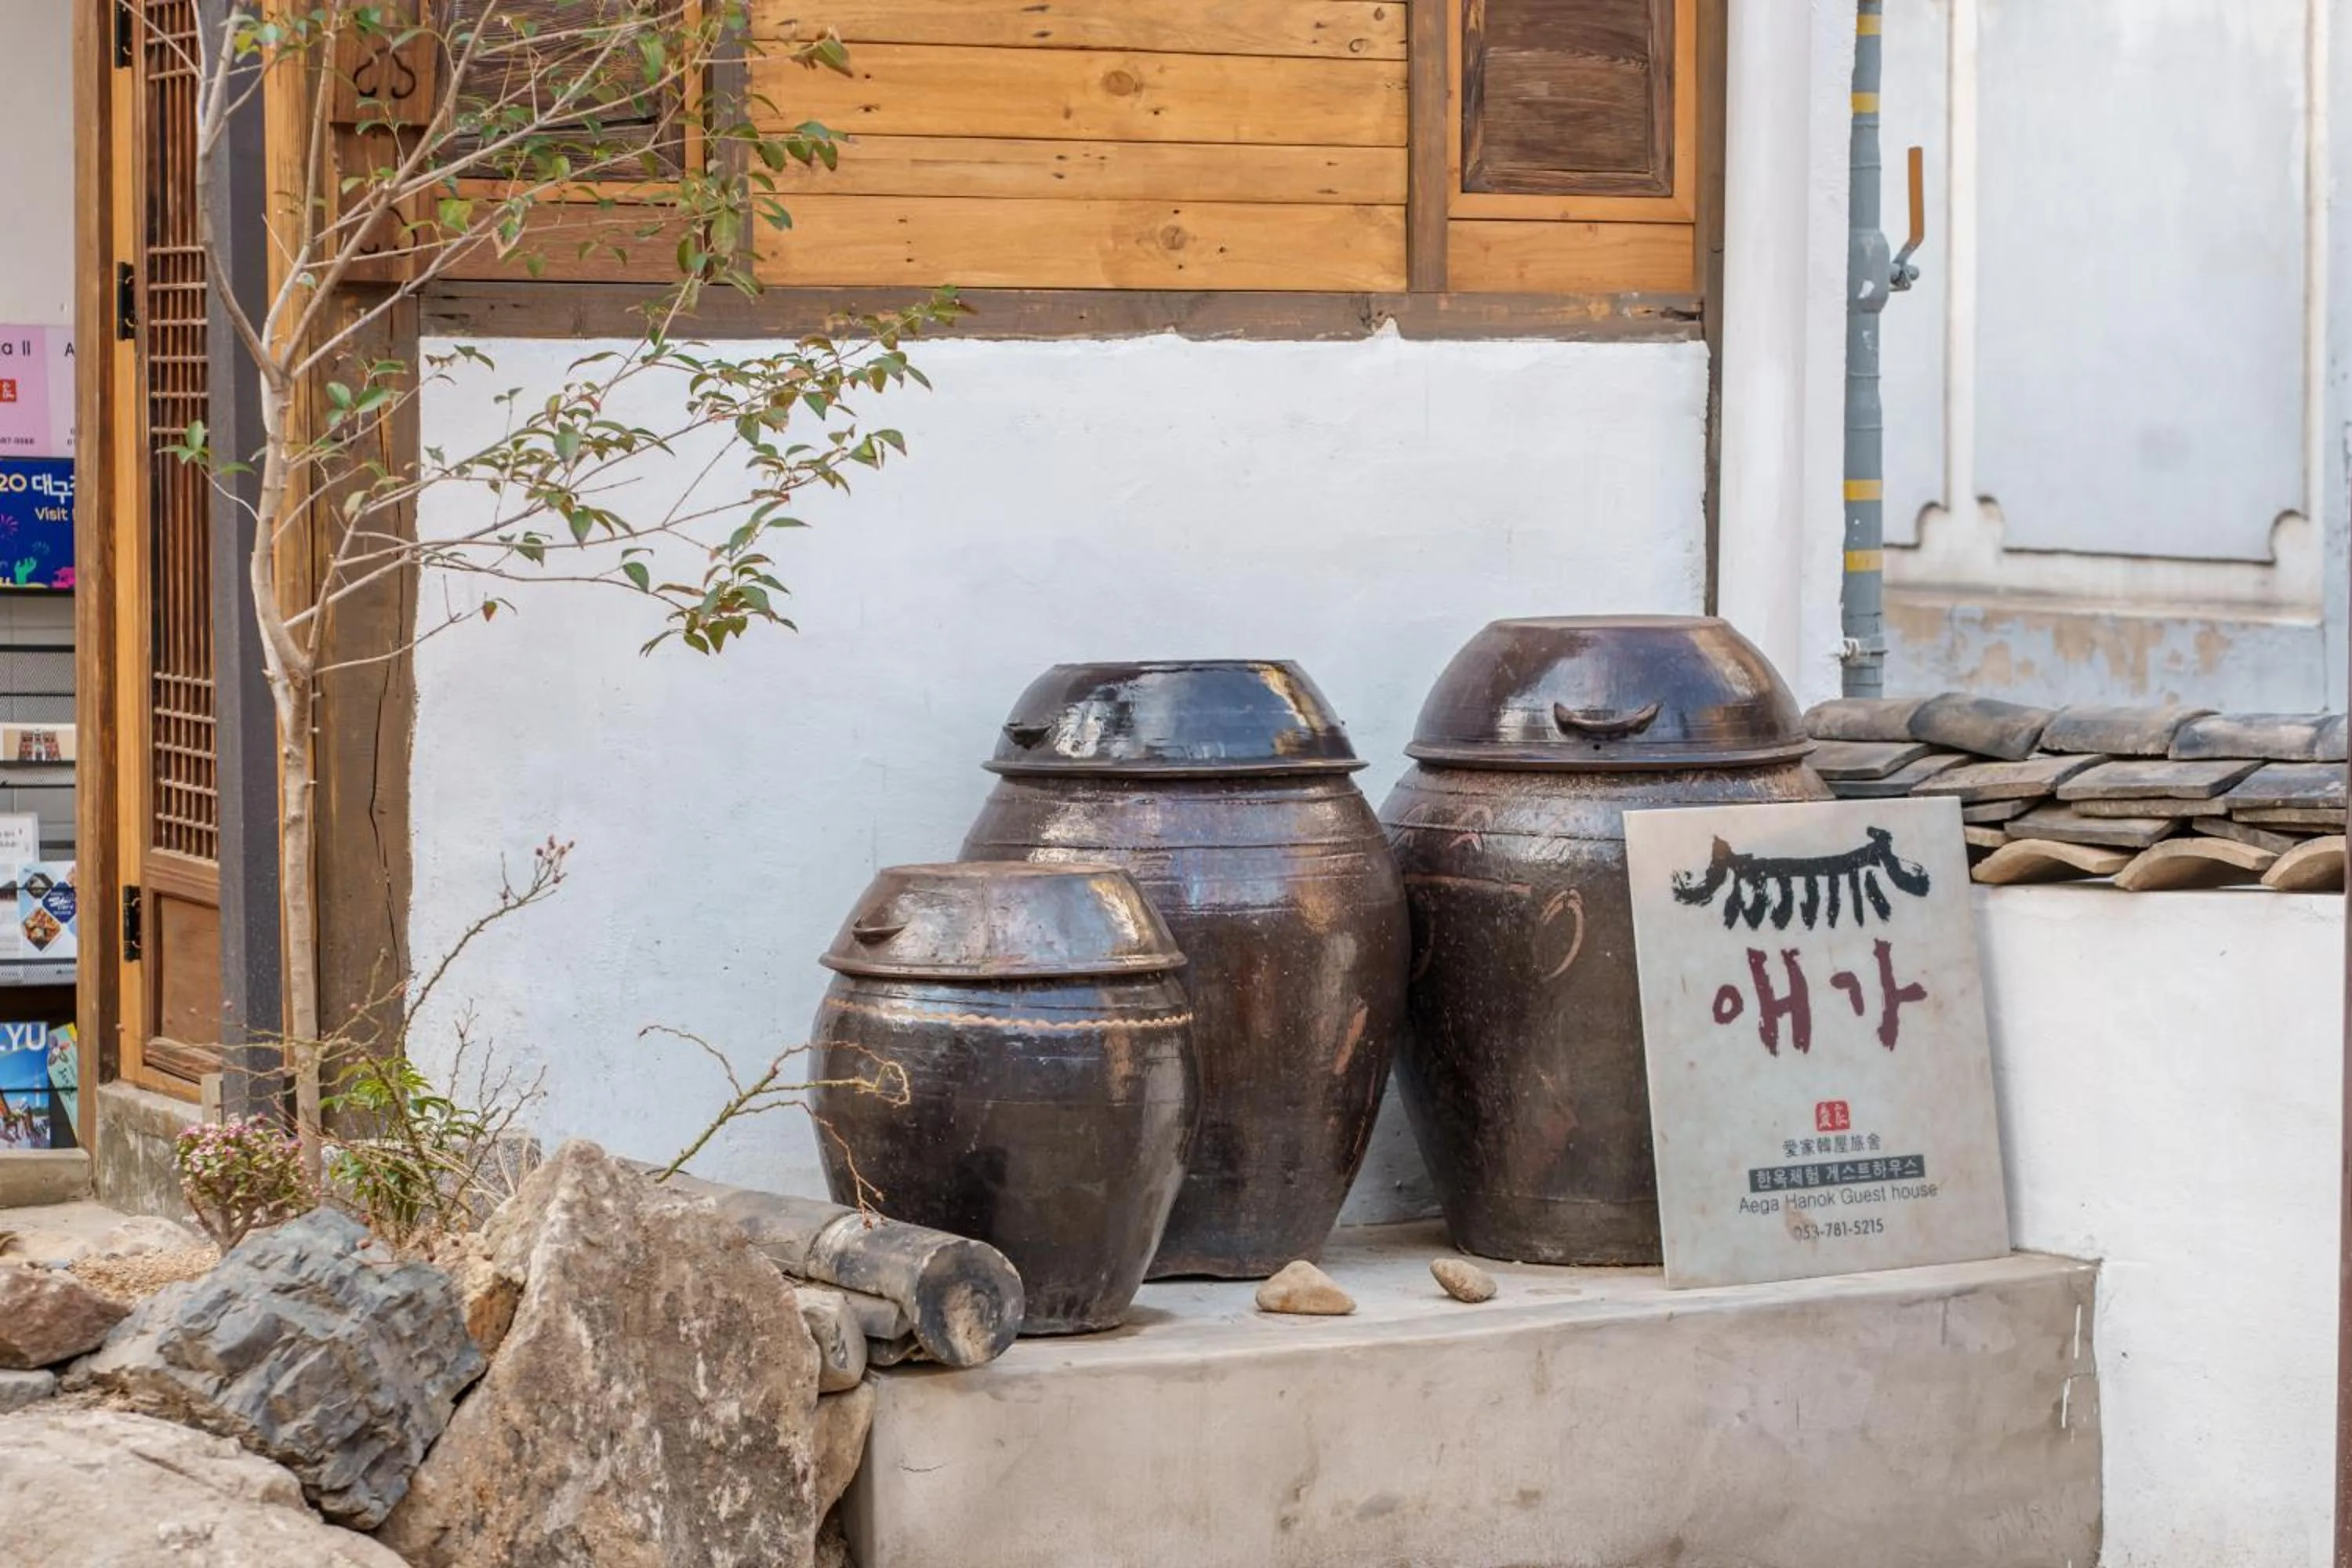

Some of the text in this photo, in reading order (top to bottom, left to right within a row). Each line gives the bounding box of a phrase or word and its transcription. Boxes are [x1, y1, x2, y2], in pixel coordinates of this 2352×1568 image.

[34, 506, 68, 521] Visit
[1712, 937, 1928, 1056] 애가
[1755, 1159, 1919, 1189] 한옥체험 게스트하우스
[1738, 1183, 1938, 1215] Aega Hanok Guest house
[1793, 1218, 1885, 1241] 053-781-5215
